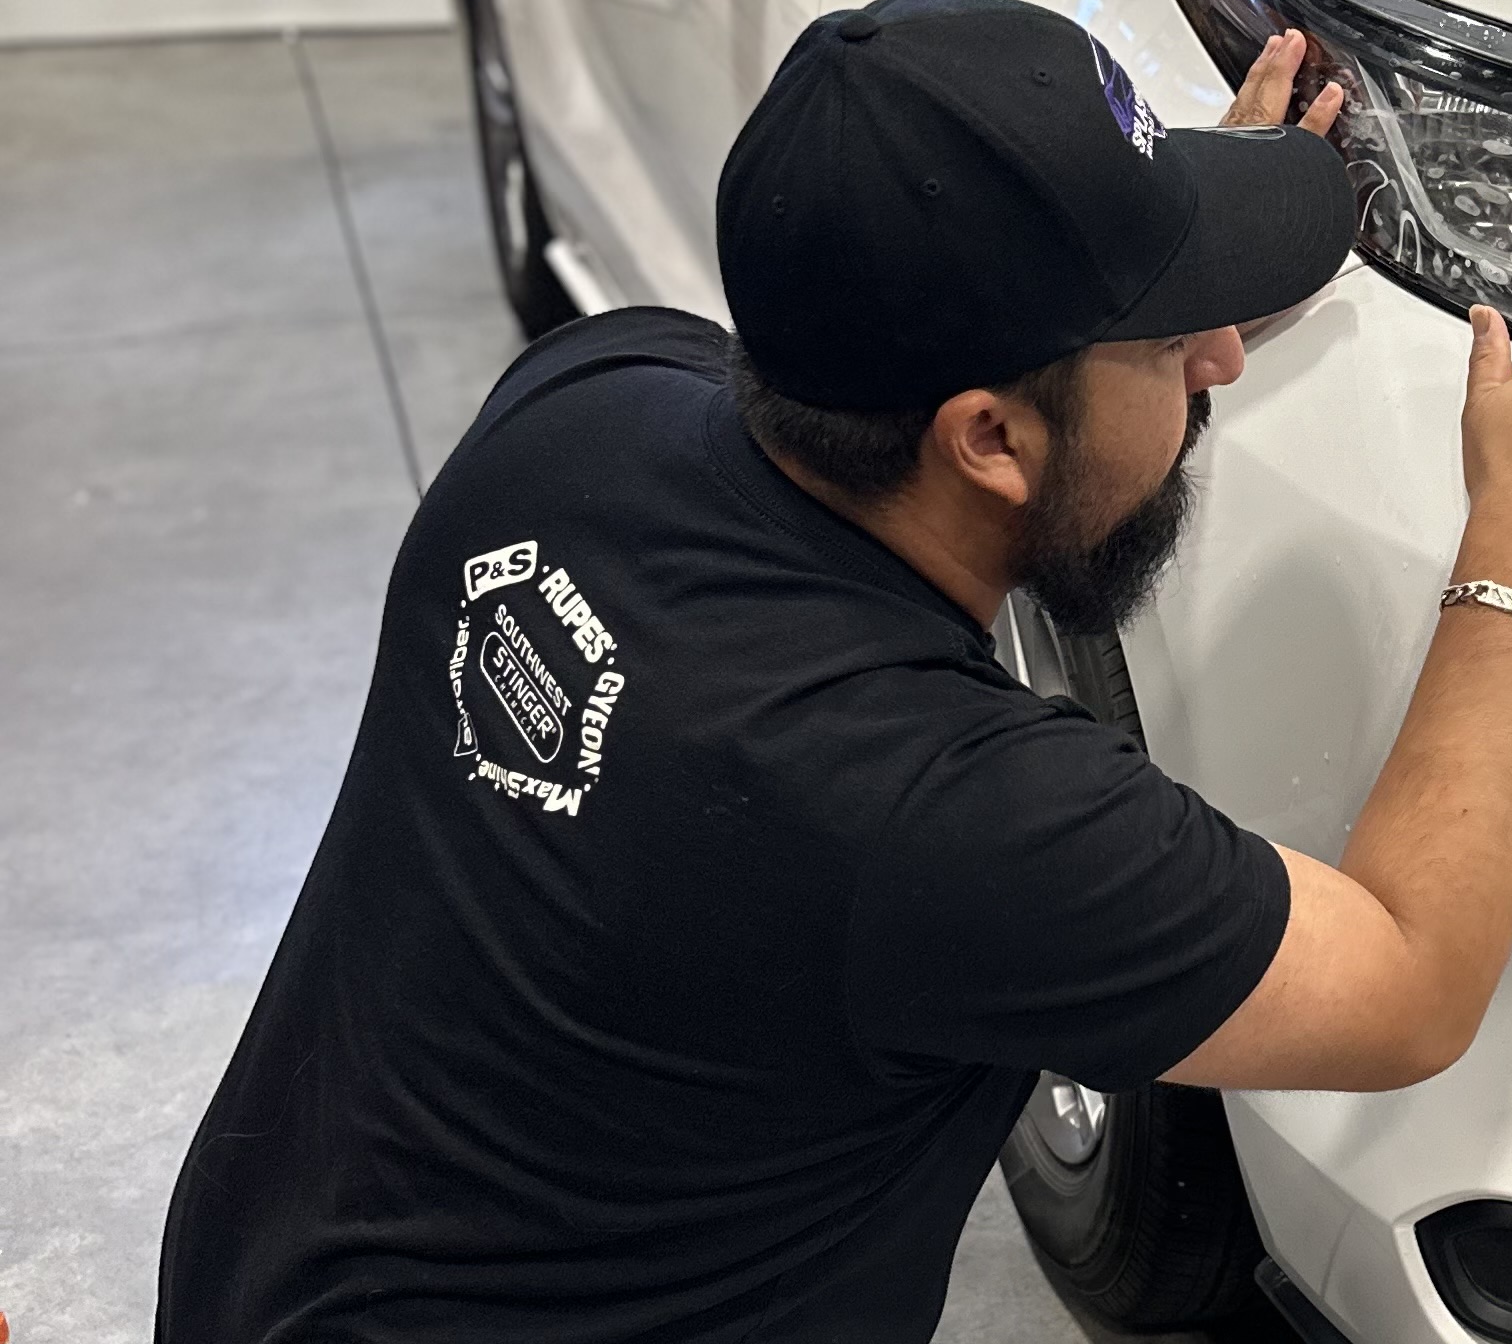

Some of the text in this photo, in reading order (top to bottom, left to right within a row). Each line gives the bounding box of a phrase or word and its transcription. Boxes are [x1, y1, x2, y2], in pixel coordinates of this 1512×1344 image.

[469, 548, 533, 593] P&S
[538, 567, 614, 663] RUPES
[492, 646, 556, 740] STINGER
[494, 603, 573, 716] SOUTHWEST
[577, 671, 625, 776] GYEON
